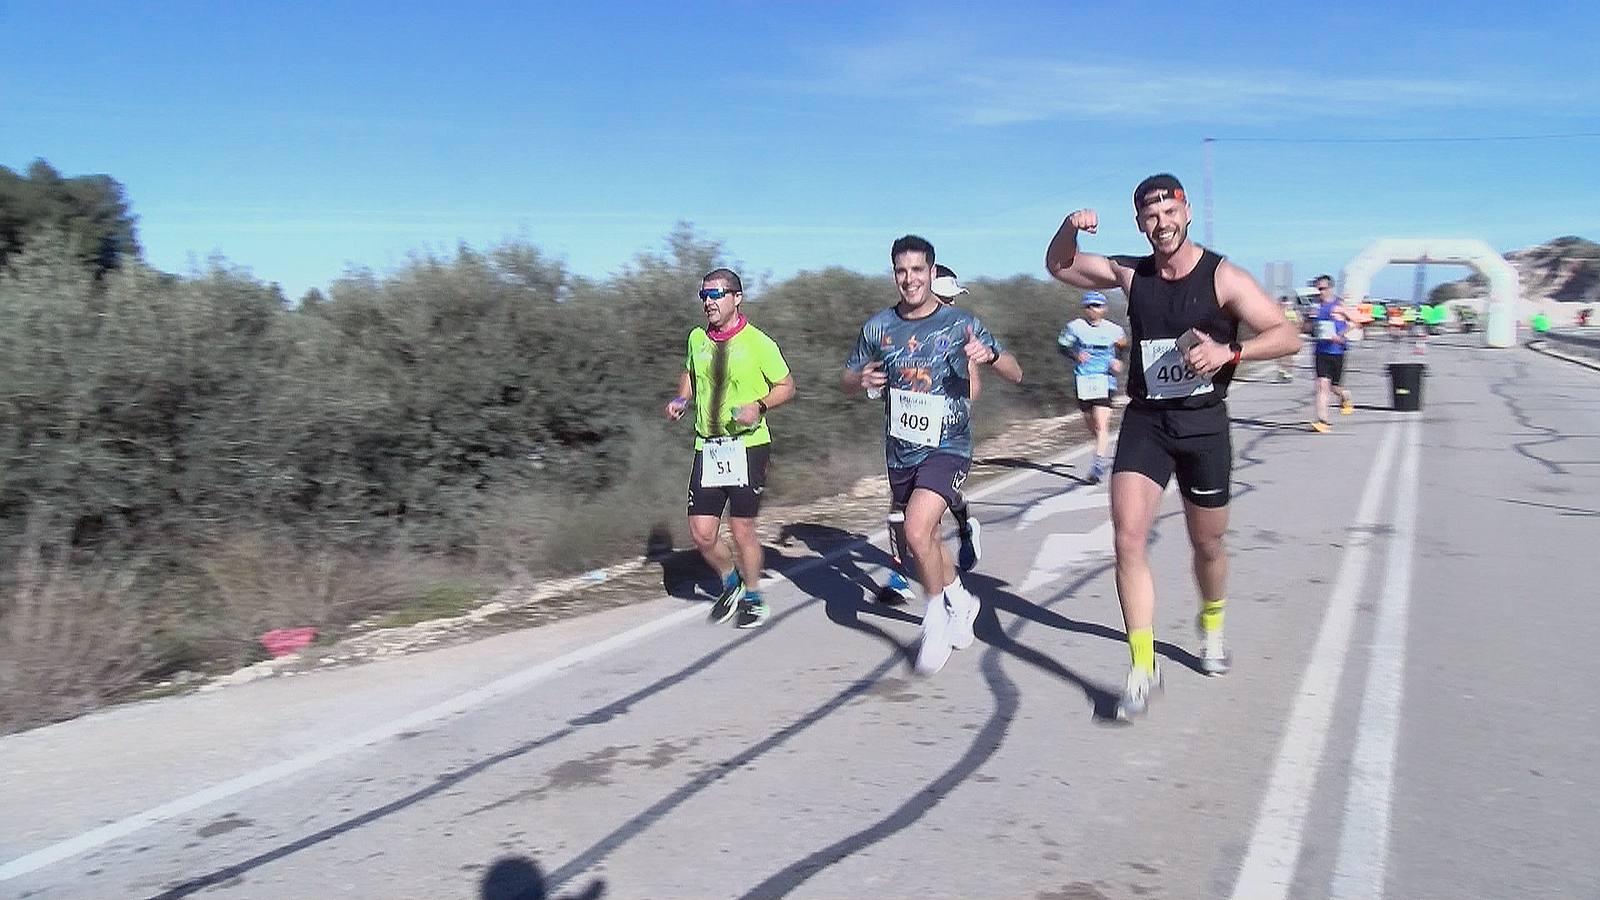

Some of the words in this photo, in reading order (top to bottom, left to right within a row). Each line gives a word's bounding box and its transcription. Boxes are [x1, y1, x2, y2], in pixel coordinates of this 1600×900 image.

[1157, 365, 1195, 382] 408
[900, 412, 929, 431] 409
[717, 461, 731, 474] 51
